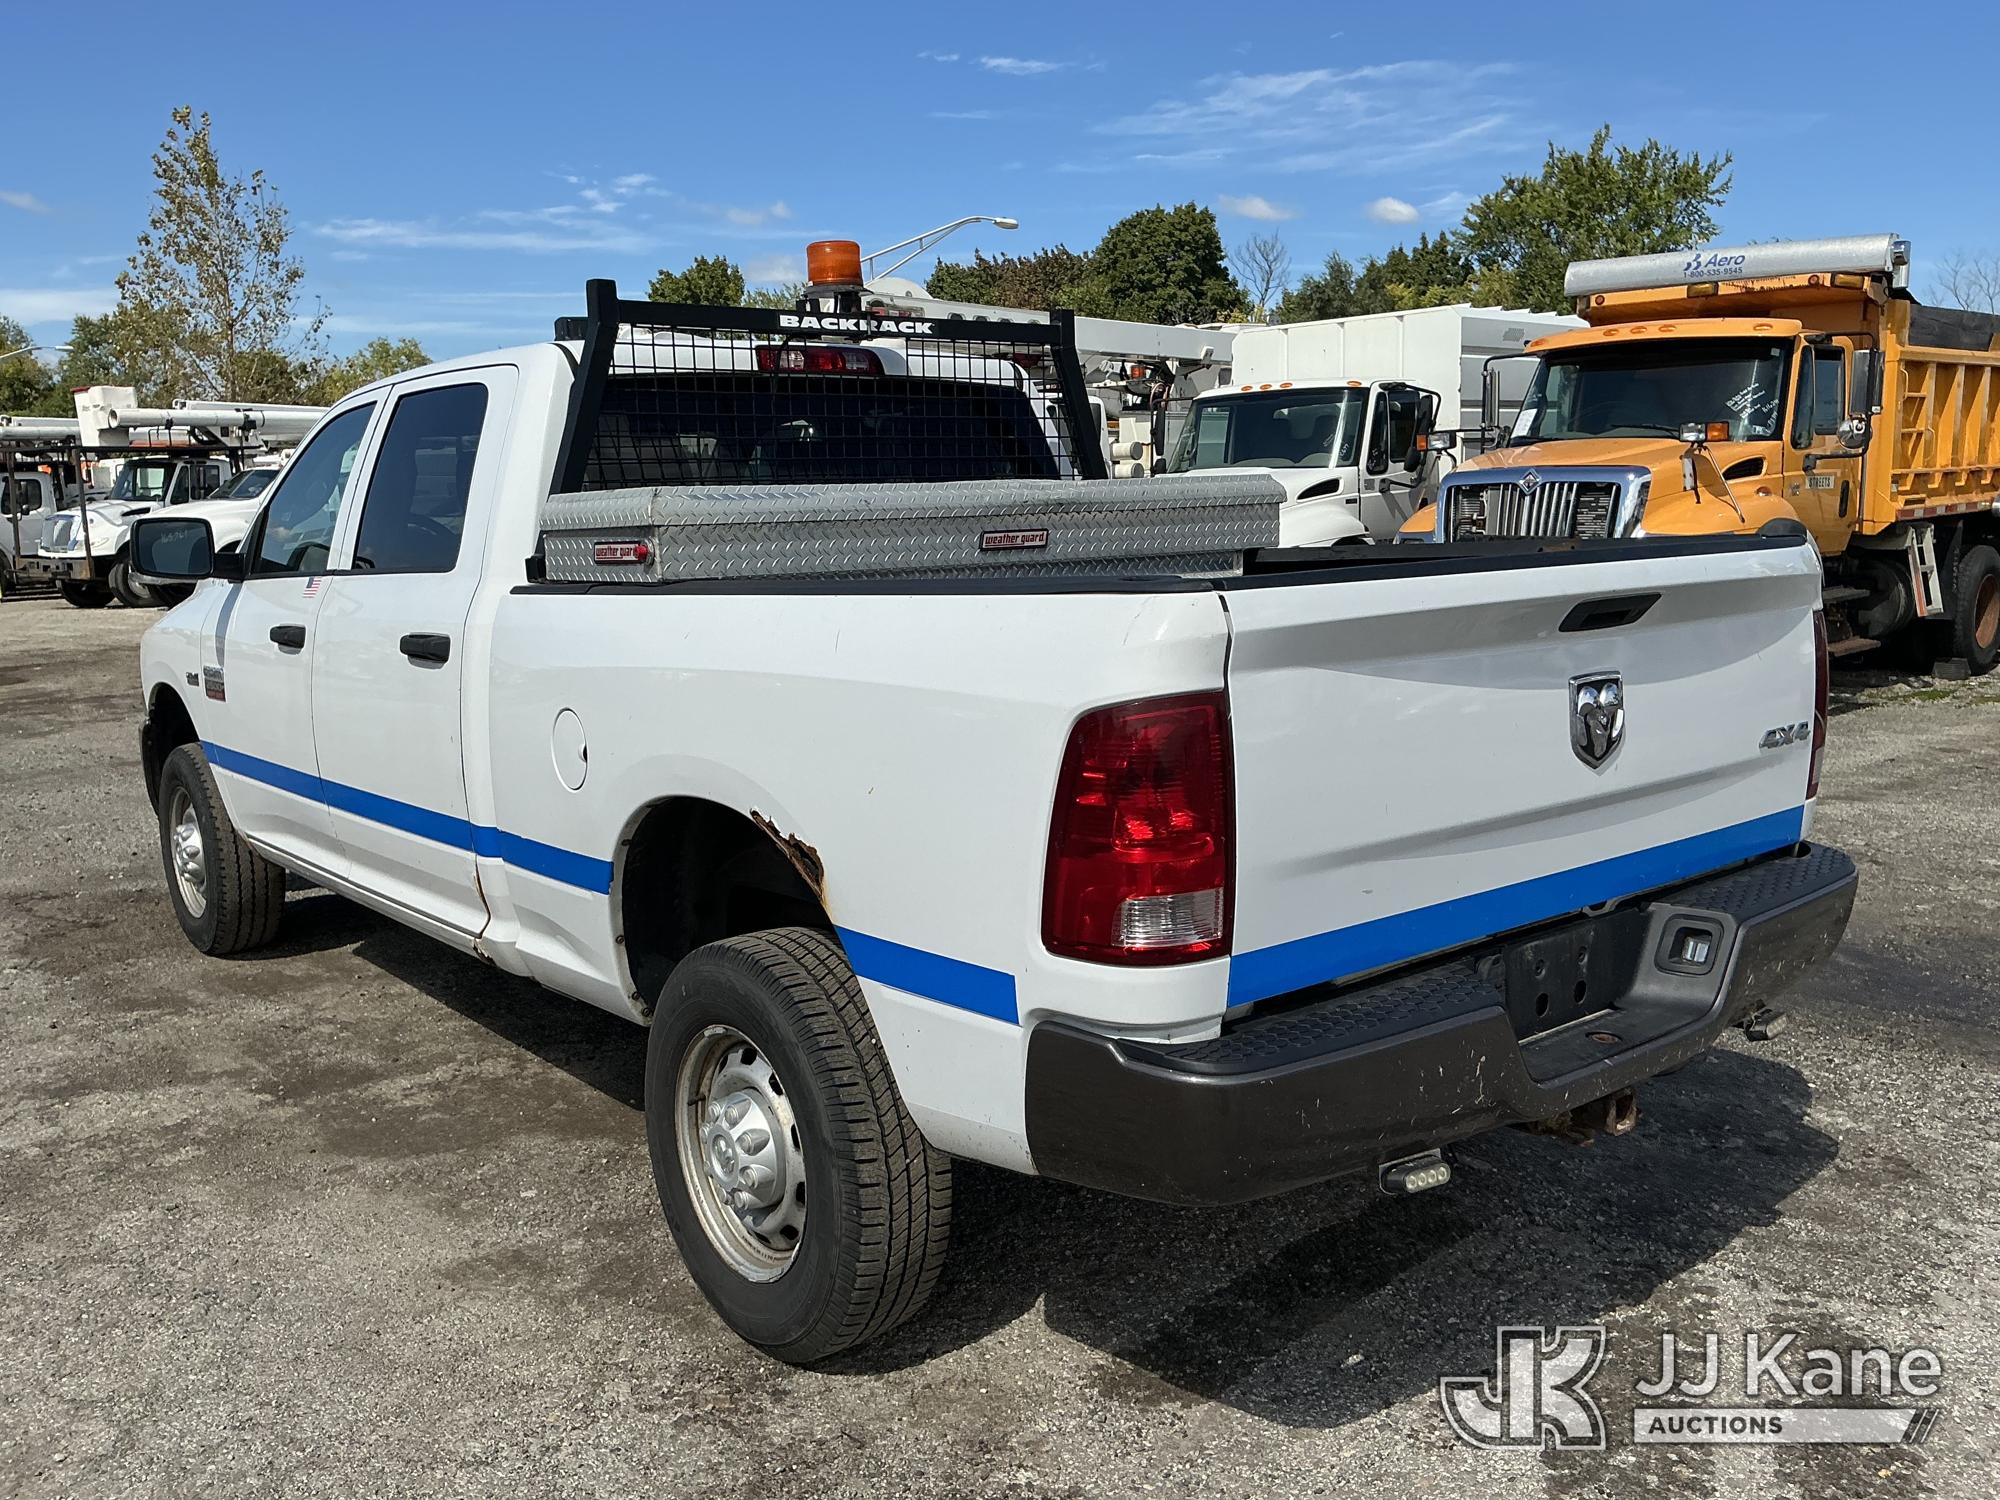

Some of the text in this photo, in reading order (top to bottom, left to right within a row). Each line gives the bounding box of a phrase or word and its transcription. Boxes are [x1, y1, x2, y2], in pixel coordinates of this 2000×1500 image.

[1704, 253, 1746, 268] Aero
[1683, 266, 1743, 279] 1-800-535-9545
[779, 314, 933, 334] BACKRACK
[1808, 475, 1831, 488] STREETS
[985, 532, 1045, 545] weather guard
[595, 546, 619, 557] weather
